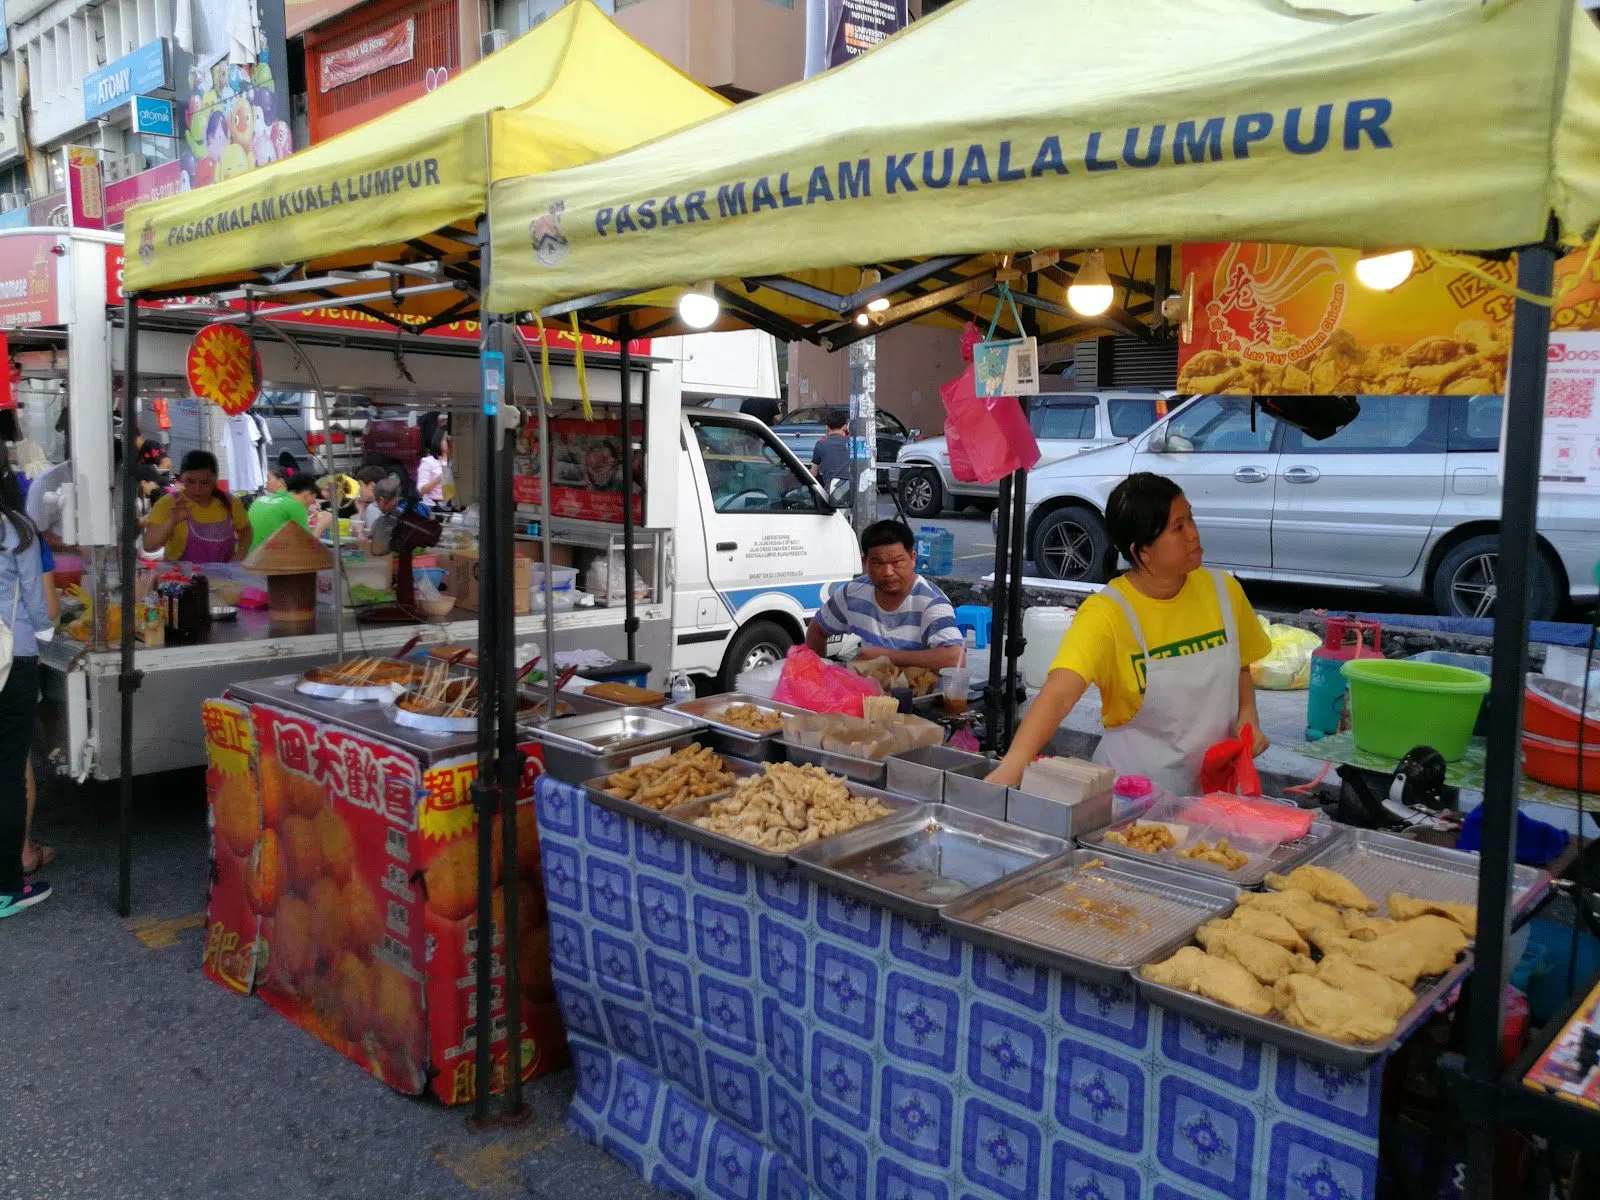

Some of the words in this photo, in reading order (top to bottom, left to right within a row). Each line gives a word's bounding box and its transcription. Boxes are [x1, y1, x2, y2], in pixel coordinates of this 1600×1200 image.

[846, 45, 858, 54] TOP
[854, 25, 887, 40] UNIVERSITY
[98, 67, 131, 105] ATOMY
[595, 189, 711, 237] PASAR
[719, 157, 871, 218] MALAM
[885, 134, 1070, 194] KUALA
[1084, 96, 1394, 172] LUMPUR
[167, 215, 215, 247] PASAR
[216, 196, 276, 234] MALAM
[279, 180, 344, 218] KUALA
[346, 157, 441, 203] LUMPUR
[1243, 346, 1265, 361] Lao
[1287, 331, 1328, 361] Golden
[1321, 283, 1345, 333] Chicken
